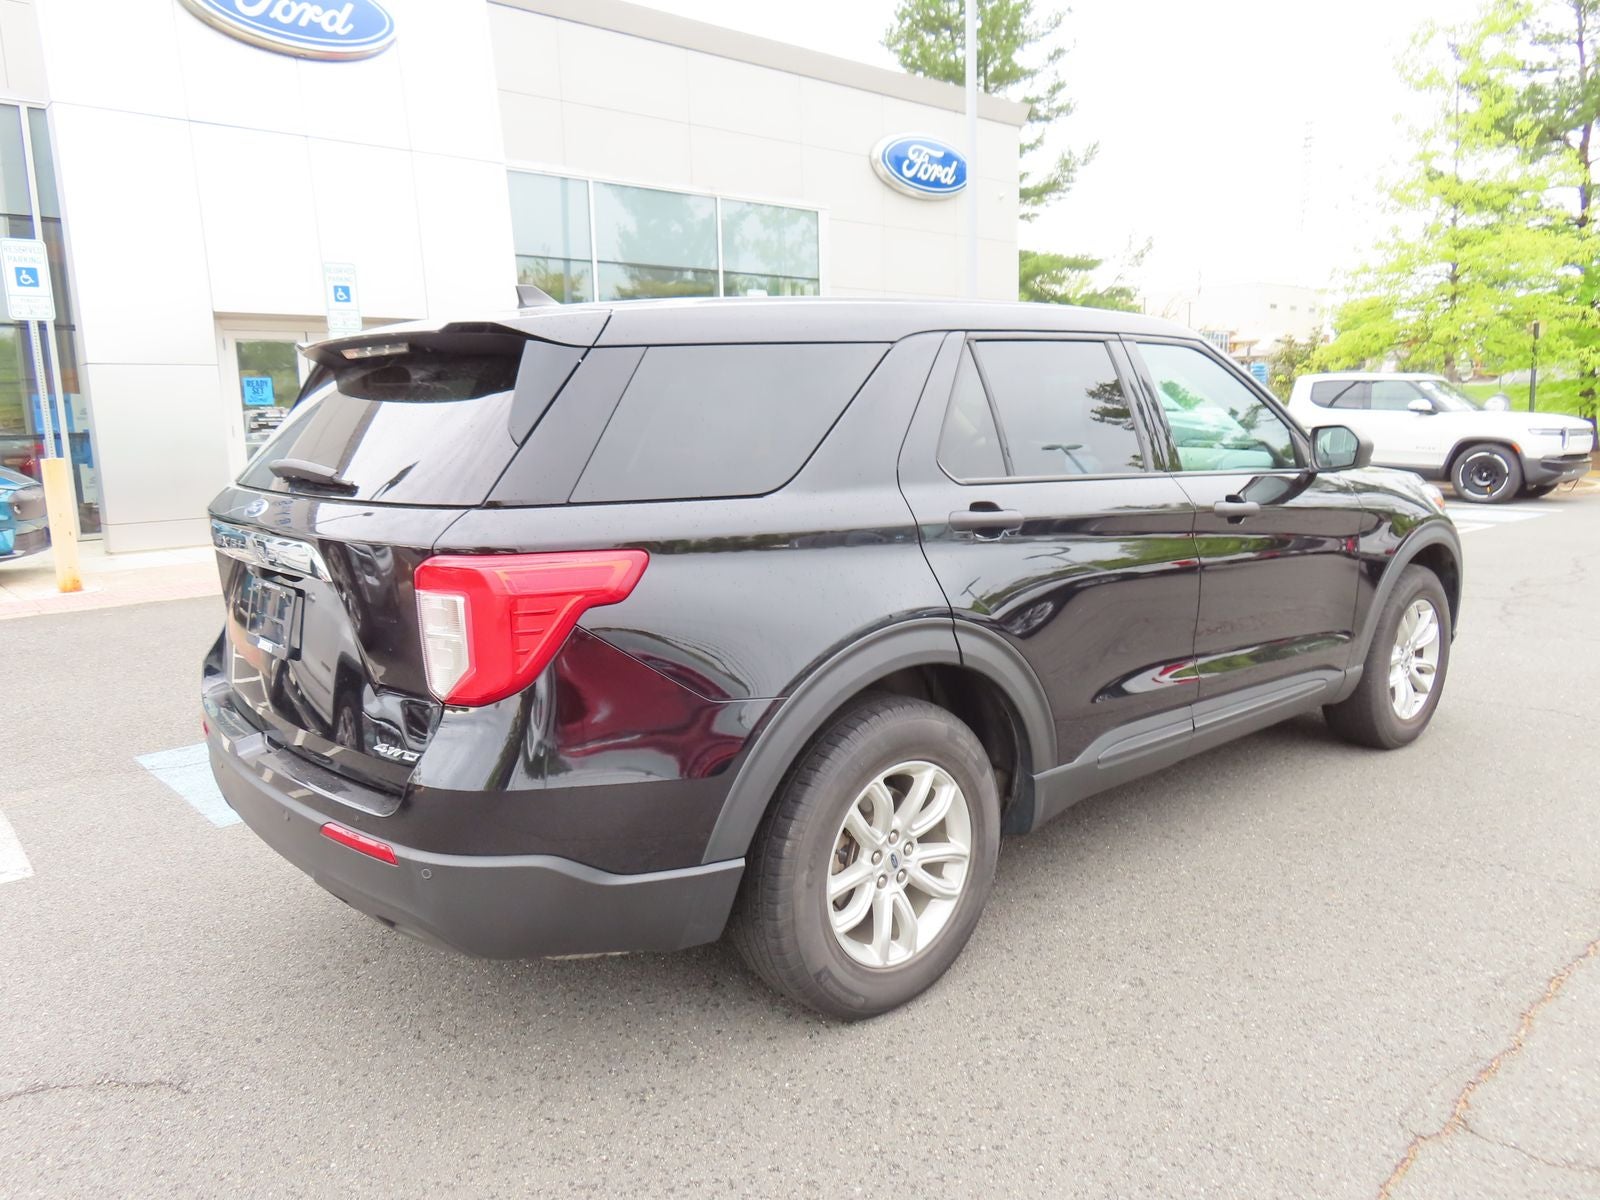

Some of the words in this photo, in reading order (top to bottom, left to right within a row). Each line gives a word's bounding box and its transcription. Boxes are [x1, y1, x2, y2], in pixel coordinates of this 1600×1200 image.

[234, 0, 354, 35] ord
[902, 144, 957, 185] Ford
[3, 246, 42, 254] RESERVED
[7, 255, 42, 264] PARKING
[246, 380, 268, 388] READY
